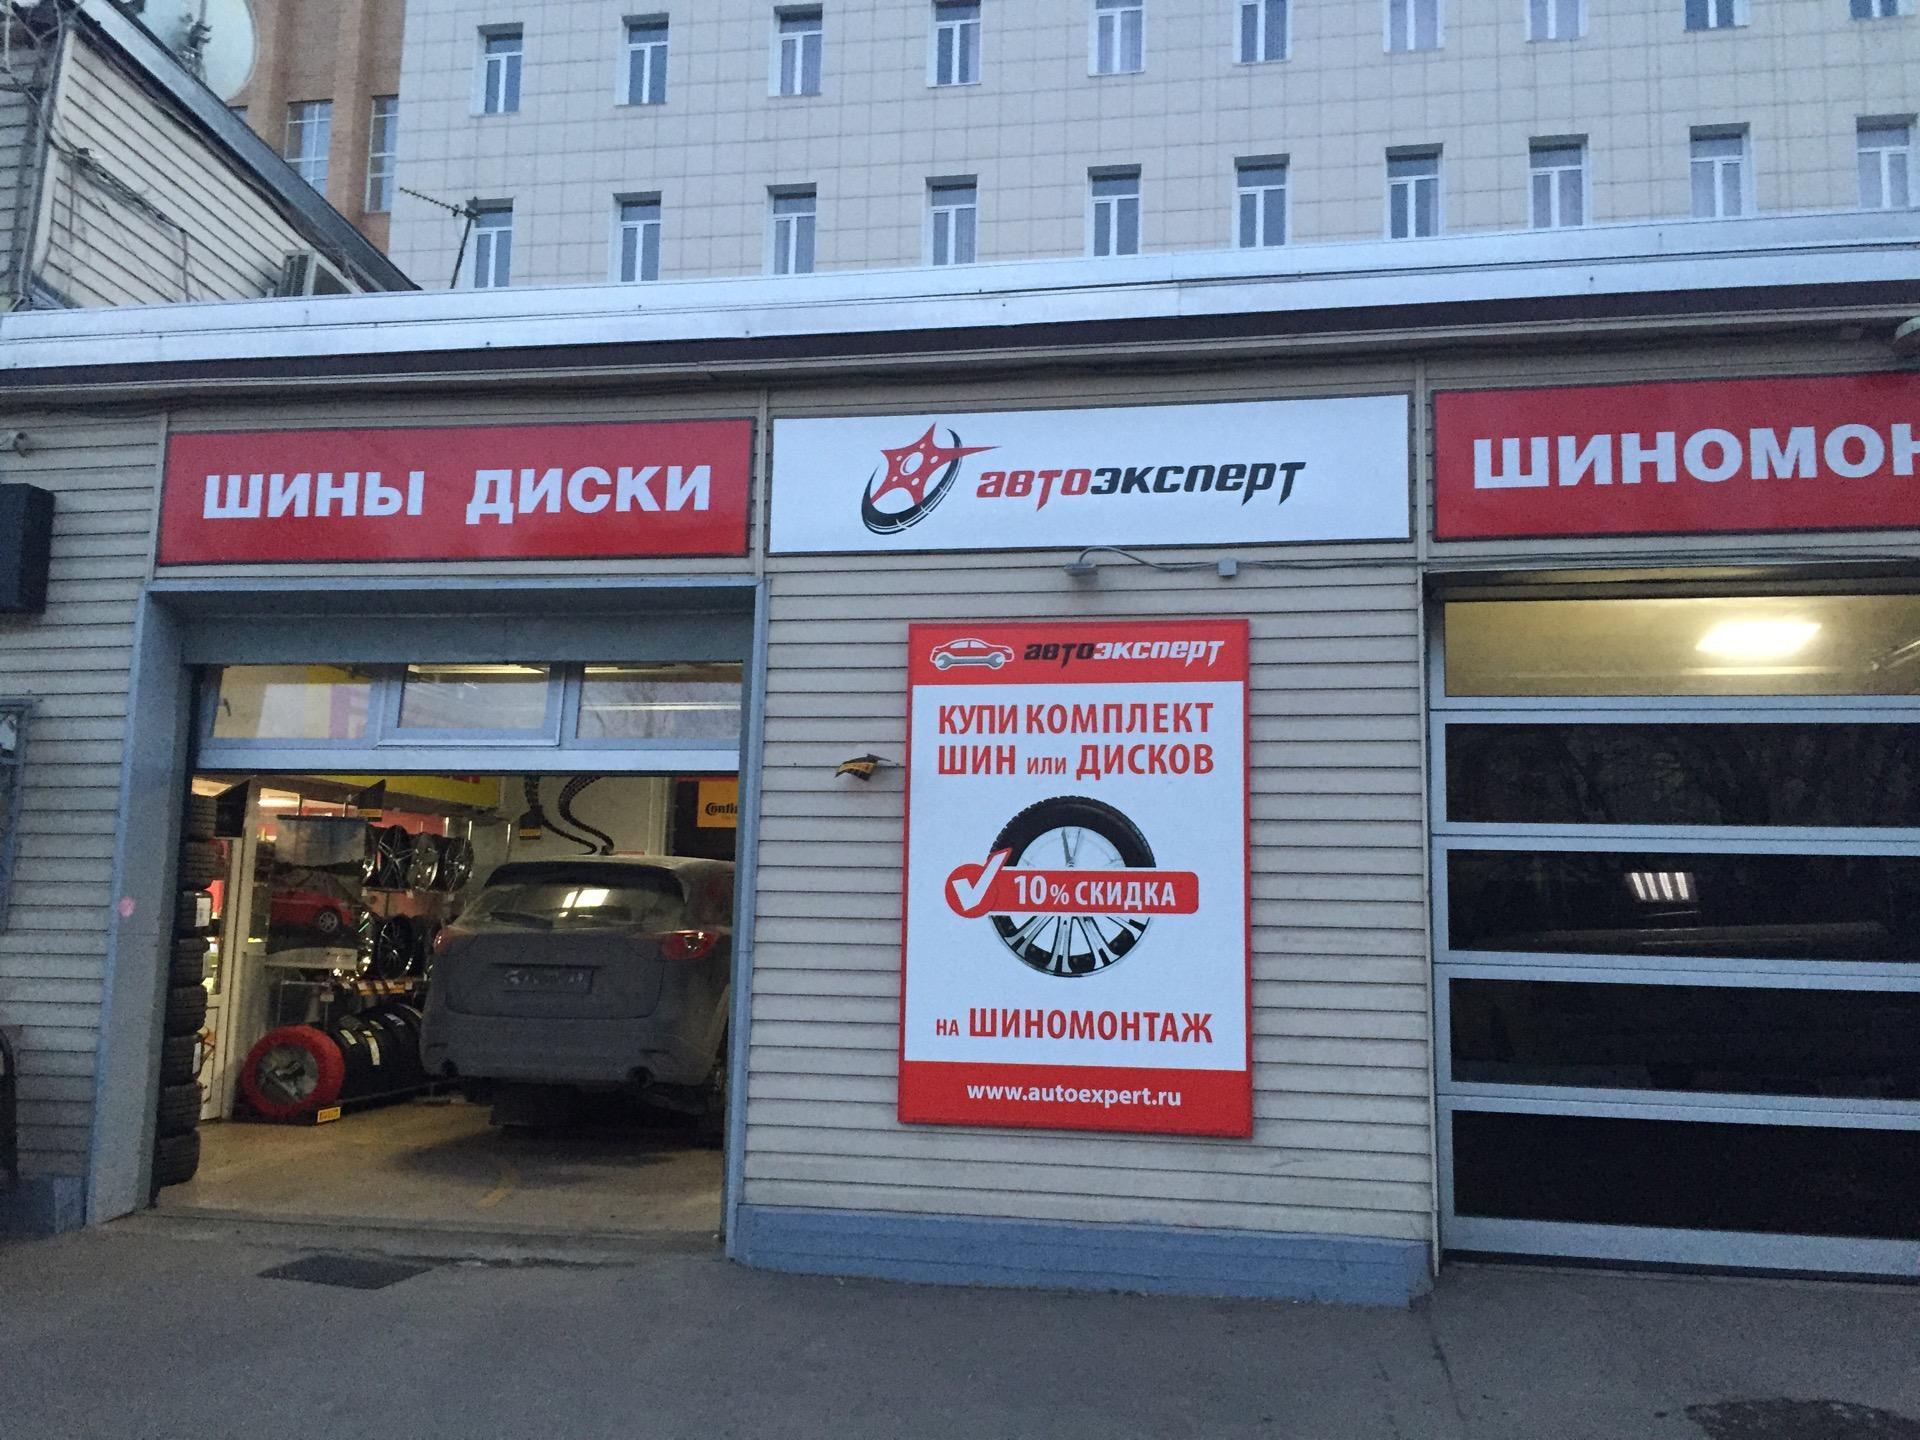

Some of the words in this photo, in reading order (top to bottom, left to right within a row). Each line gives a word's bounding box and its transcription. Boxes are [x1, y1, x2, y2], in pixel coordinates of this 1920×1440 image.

[202, 470, 425, 520] ШИНЫ
[465, 464, 712, 526] ДИСКИ
[976, 461, 1306, 512] автоэксперт
[939, 704, 1018, 735] КУПИ
[1026, 702, 1214, 734] КОМПЛЕКТ
[938, 744, 1016, 775] ШИН
[1076, 743, 1214, 781] ДИСКОВ
[1014, 875, 1070, 906] 10%
[1074, 880, 1177, 912] СКИДКА
[936, 1018, 960, 1037] НА
[968, 1007, 1213, 1043] ШИНОМОНТАЖ
[966, 1083, 1182, 1108] www.autoexpert.ru
